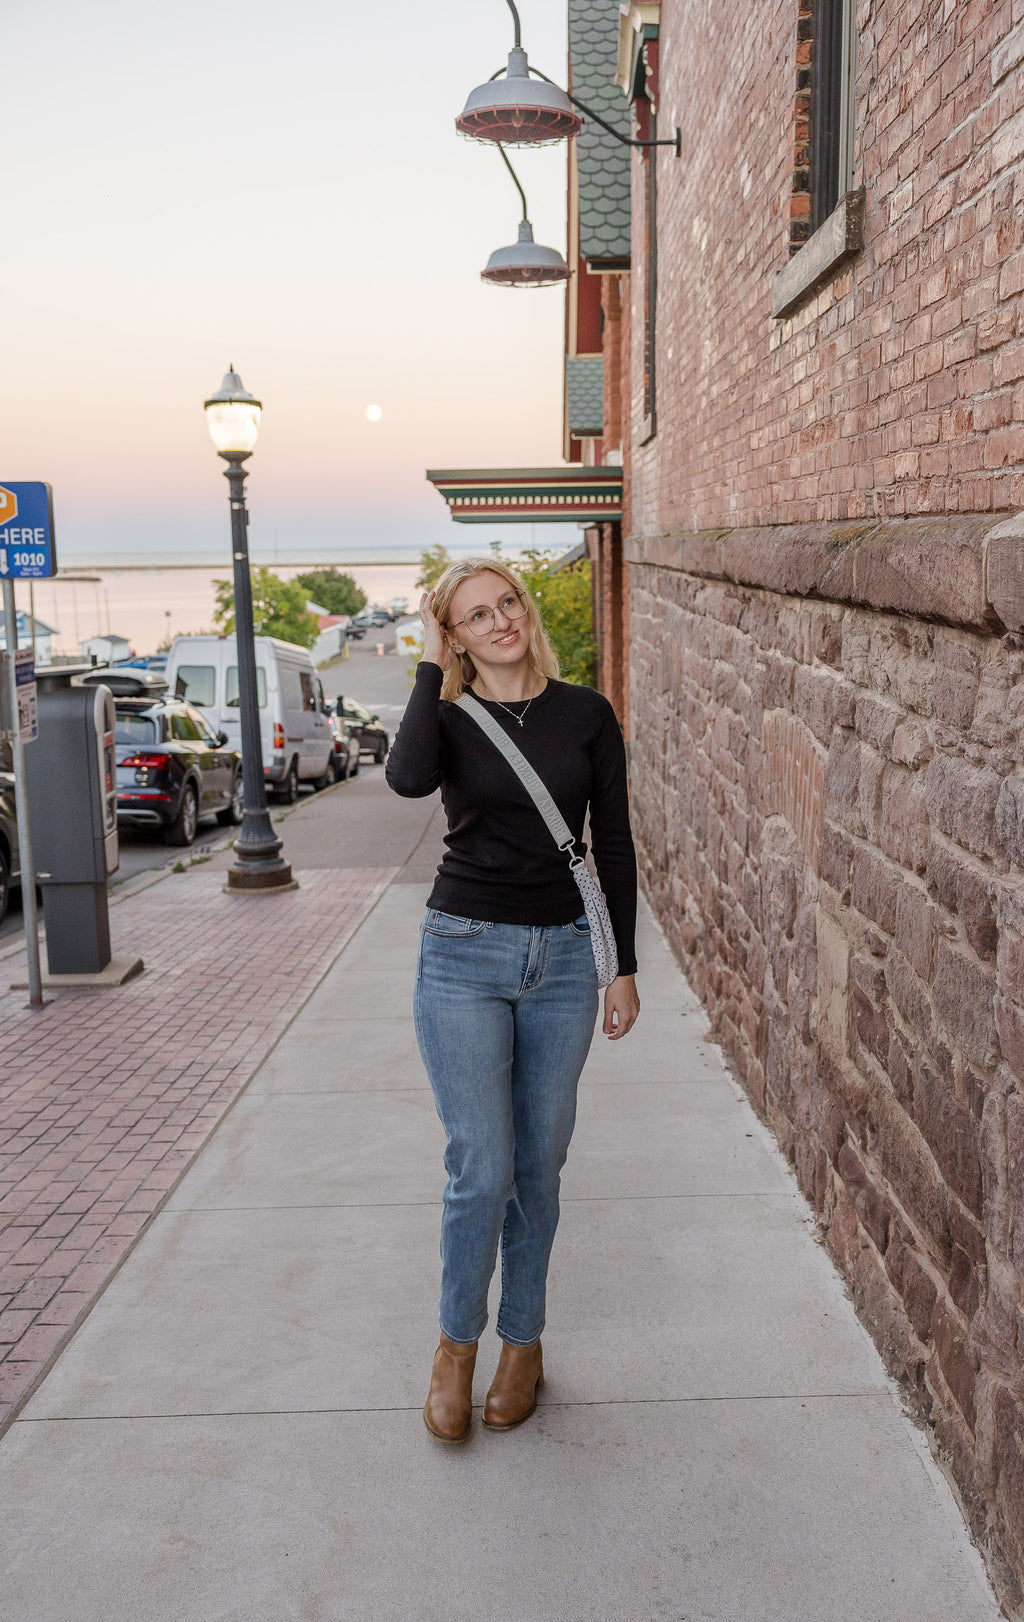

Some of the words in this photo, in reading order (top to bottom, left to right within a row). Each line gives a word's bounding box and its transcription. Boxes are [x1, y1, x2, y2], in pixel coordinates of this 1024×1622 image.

[13, 552, 46, 567] 1010
[508, 752, 541, 792] BRIXLEY
[537, 798, 566, 838] BRIXLEY
